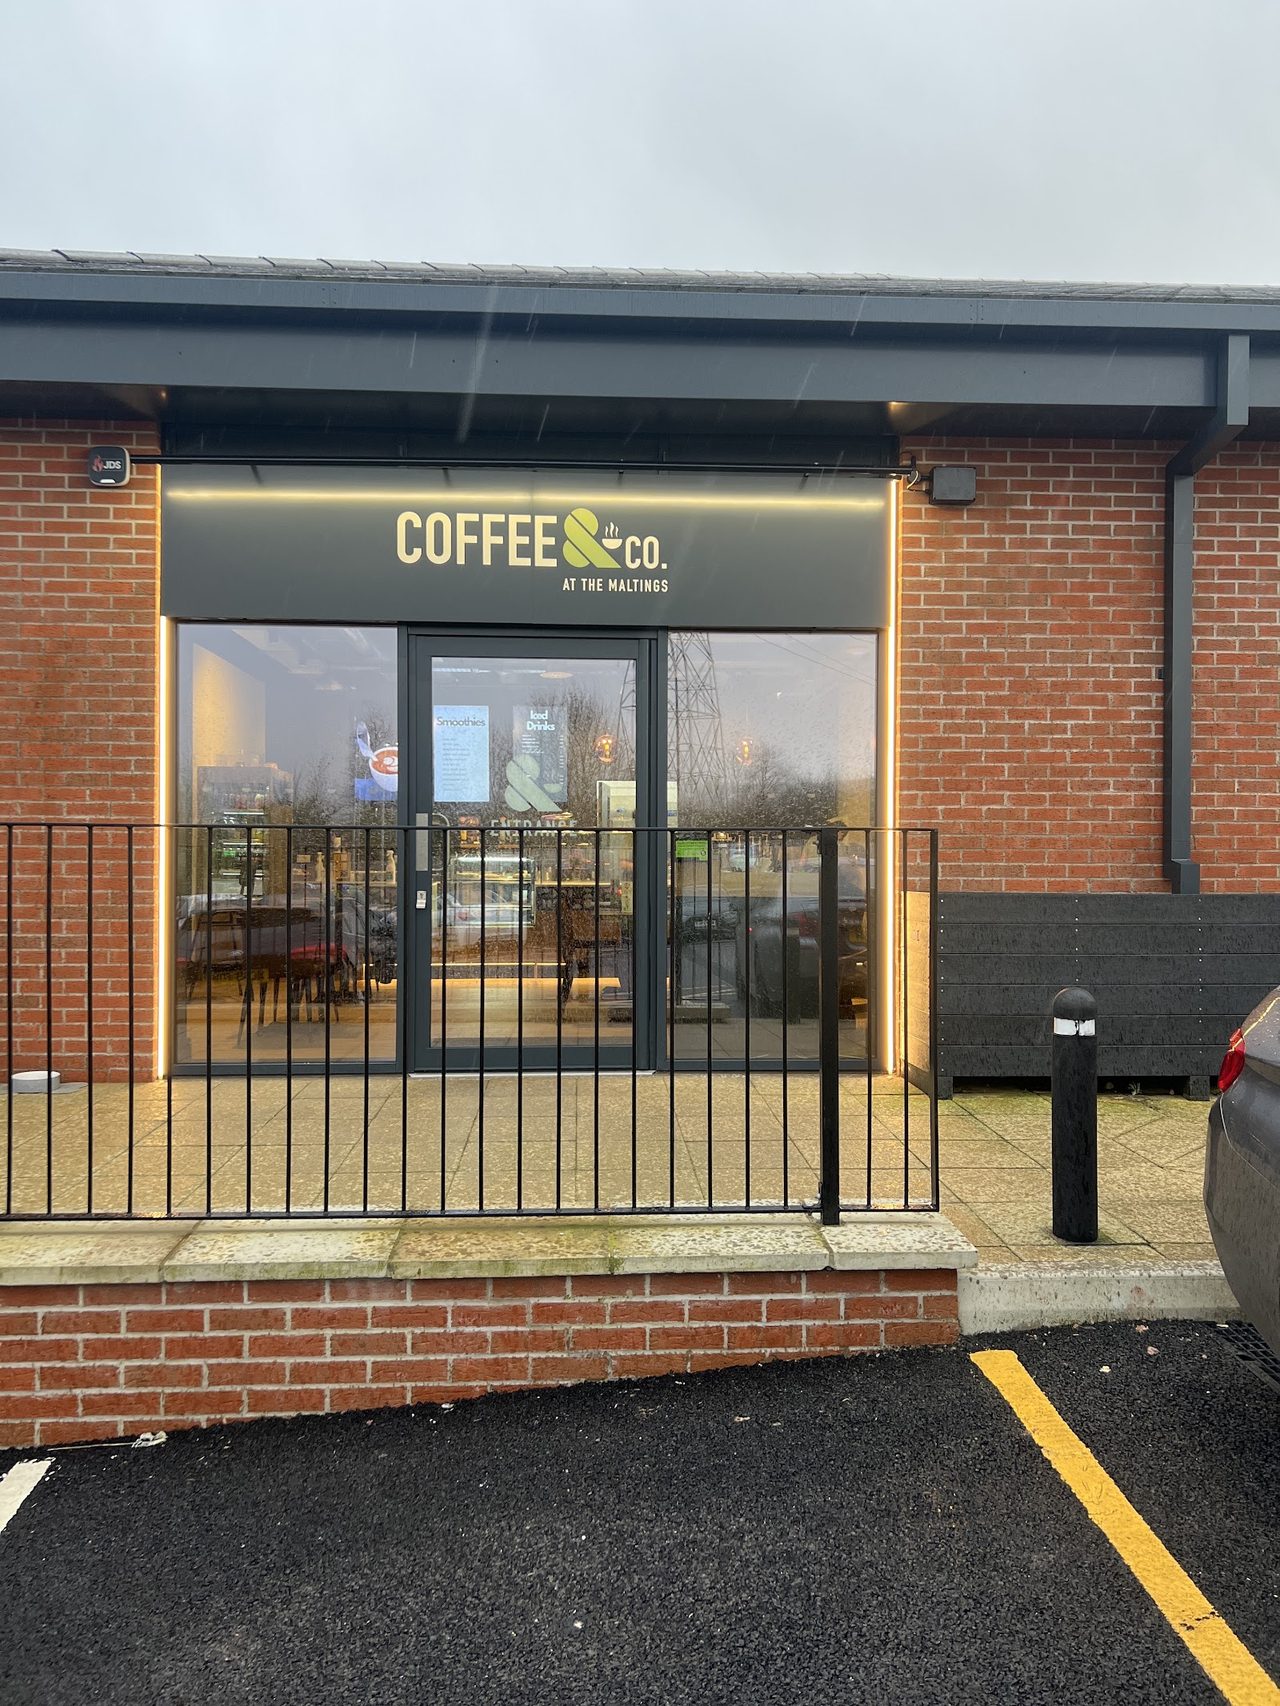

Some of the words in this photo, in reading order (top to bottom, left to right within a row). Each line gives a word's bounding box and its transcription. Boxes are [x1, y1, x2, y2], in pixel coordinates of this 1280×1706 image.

[103, 460, 121, 470] JDS
[396, 511, 558, 567] COFFEE
[562, 507, 623, 569] &
[625, 535, 668, 570] CO.
[562, 577, 576, 591] AT
[581, 578, 603, 592] THE
[608, 579, 669, 593] MALTINGS
[436, 714, 486, 727] Smoothies
[526, 720, 556, 731] Drinks
